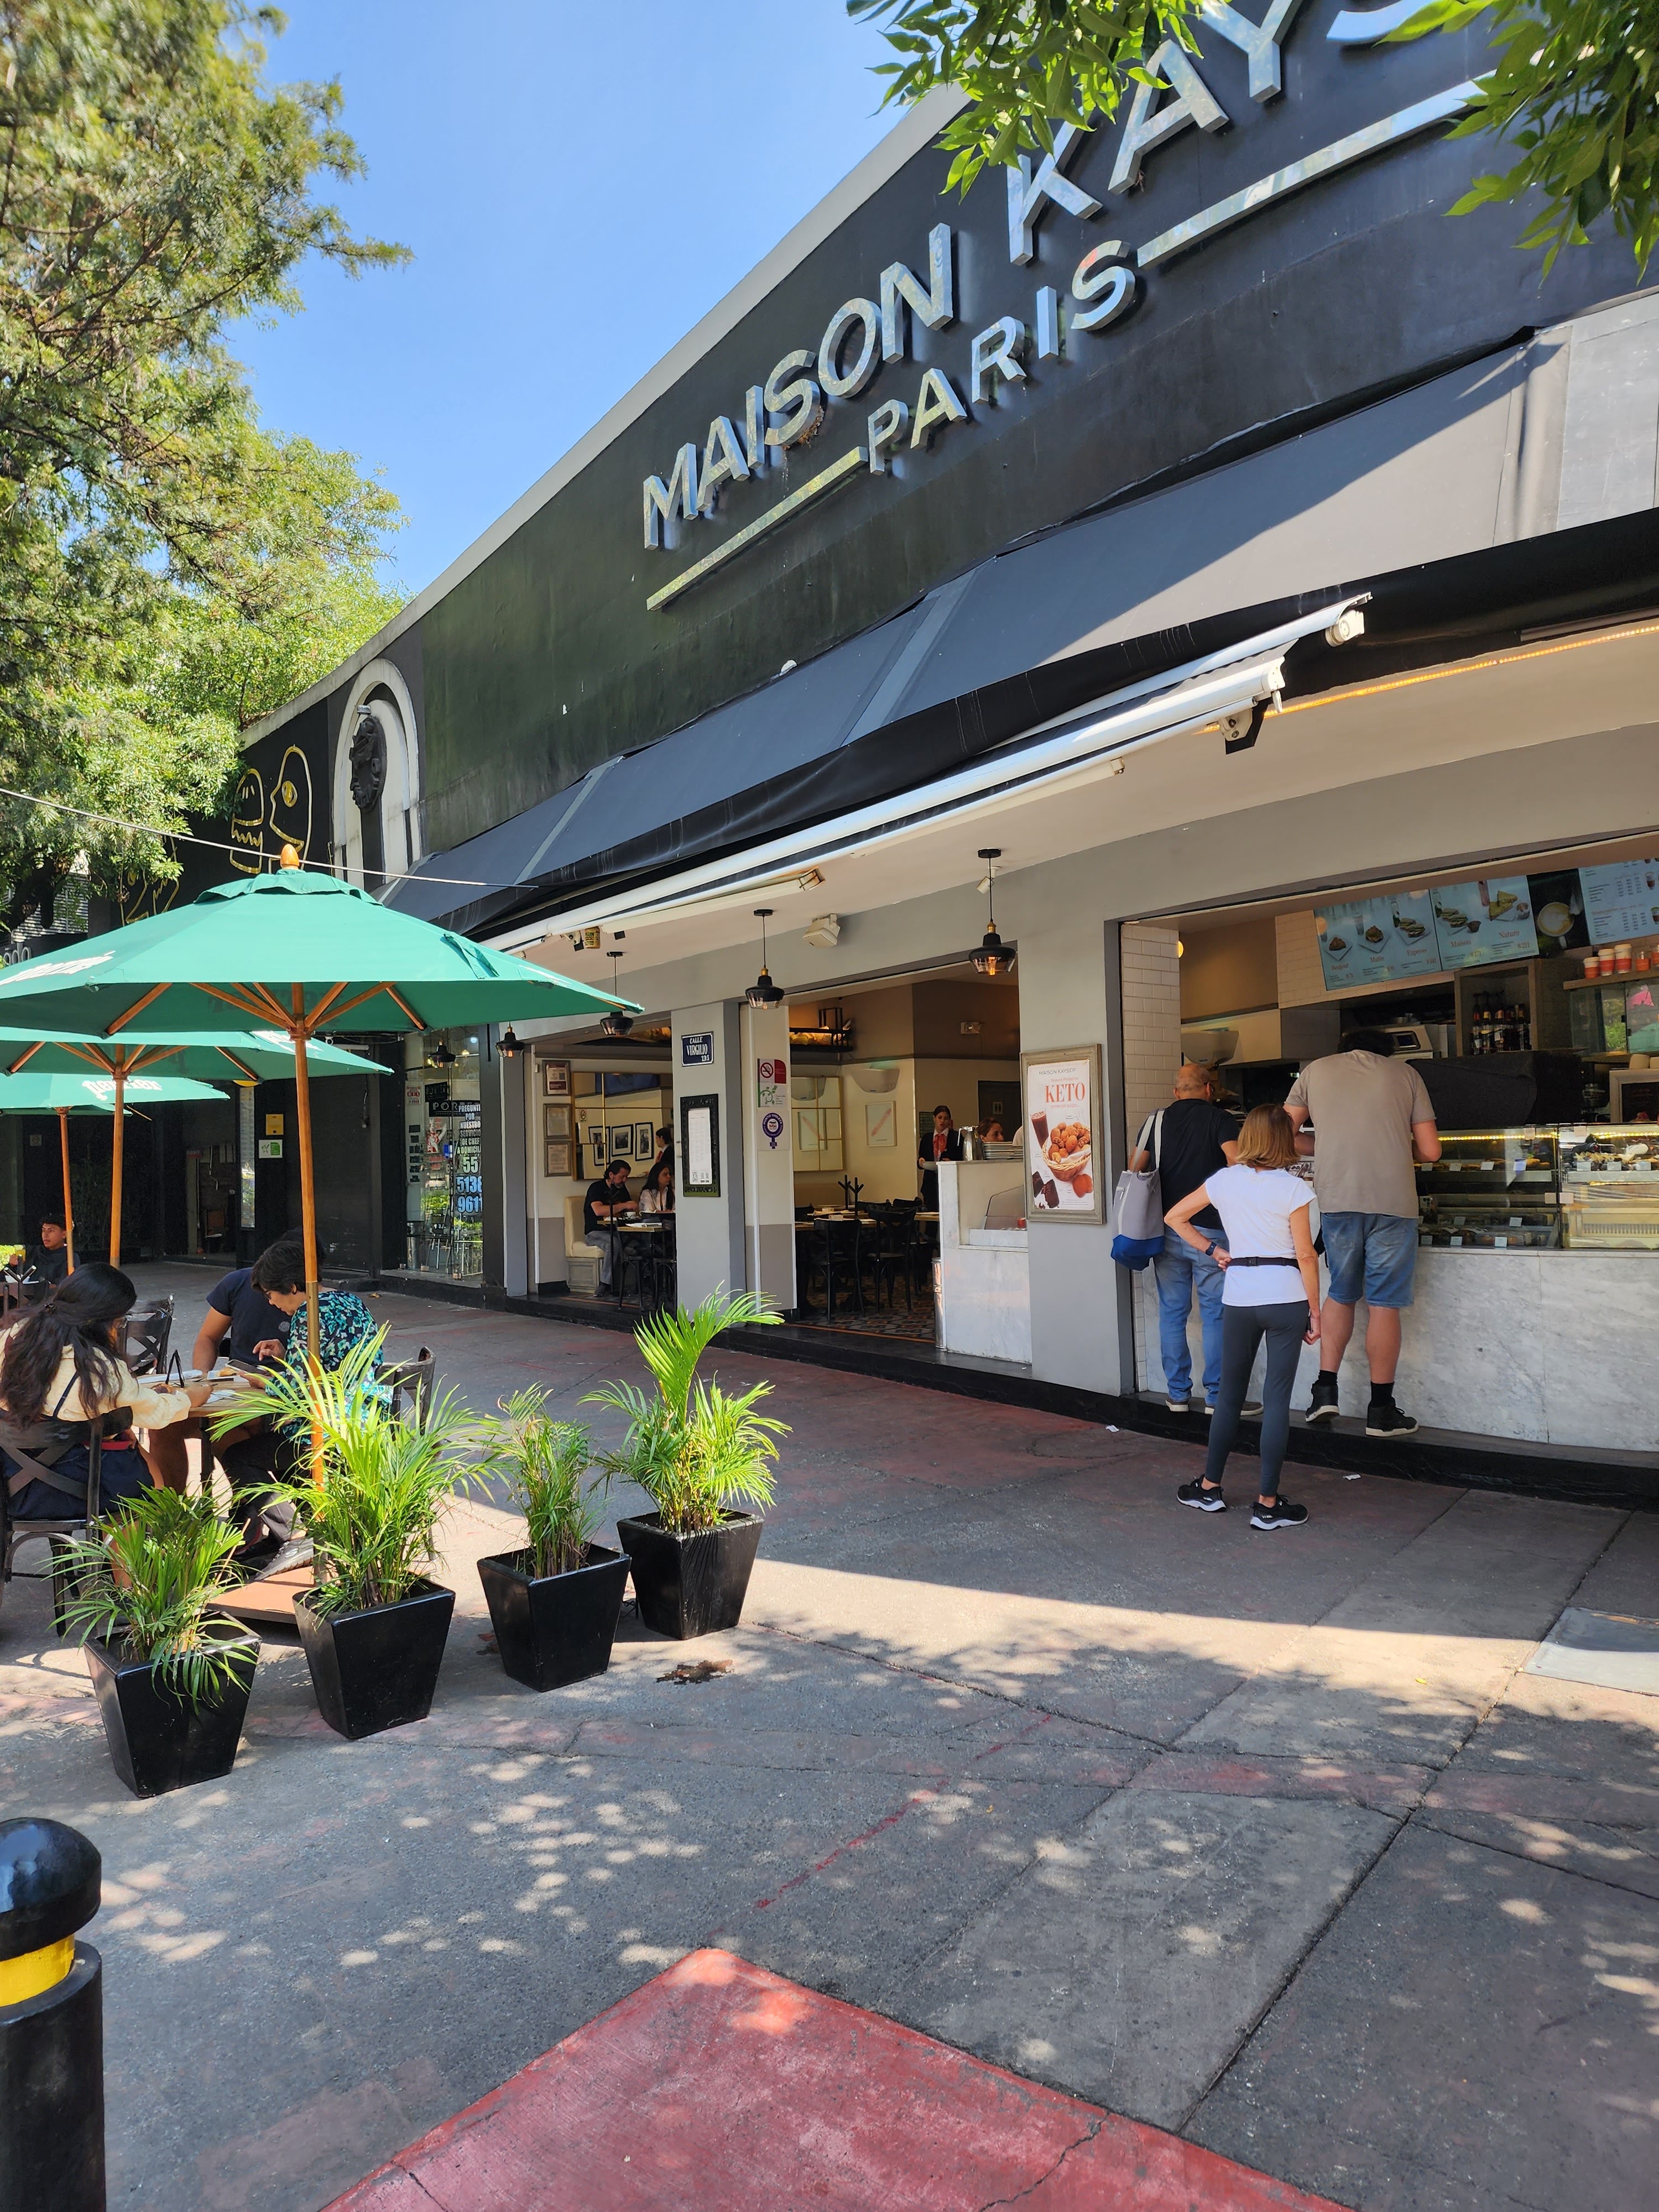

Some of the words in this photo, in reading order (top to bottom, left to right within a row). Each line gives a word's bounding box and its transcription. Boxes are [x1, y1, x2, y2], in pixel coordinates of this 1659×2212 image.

[643, 223, 953, 550] MAISON
[1006, 0, 1438, 265] KAY
[868, 239, 1135, 476] PARIS
[1499, 930, 1520, 939] Nature
[1406, 947, 1428, 957] Express
[686, 1044, 708, 1056] VIRGILIO
[1045, 1082, 1086, 1103] KETO
[460, 1129, 481, 1137] SERVICIO
[463, 1156, 478, 1173] 55
